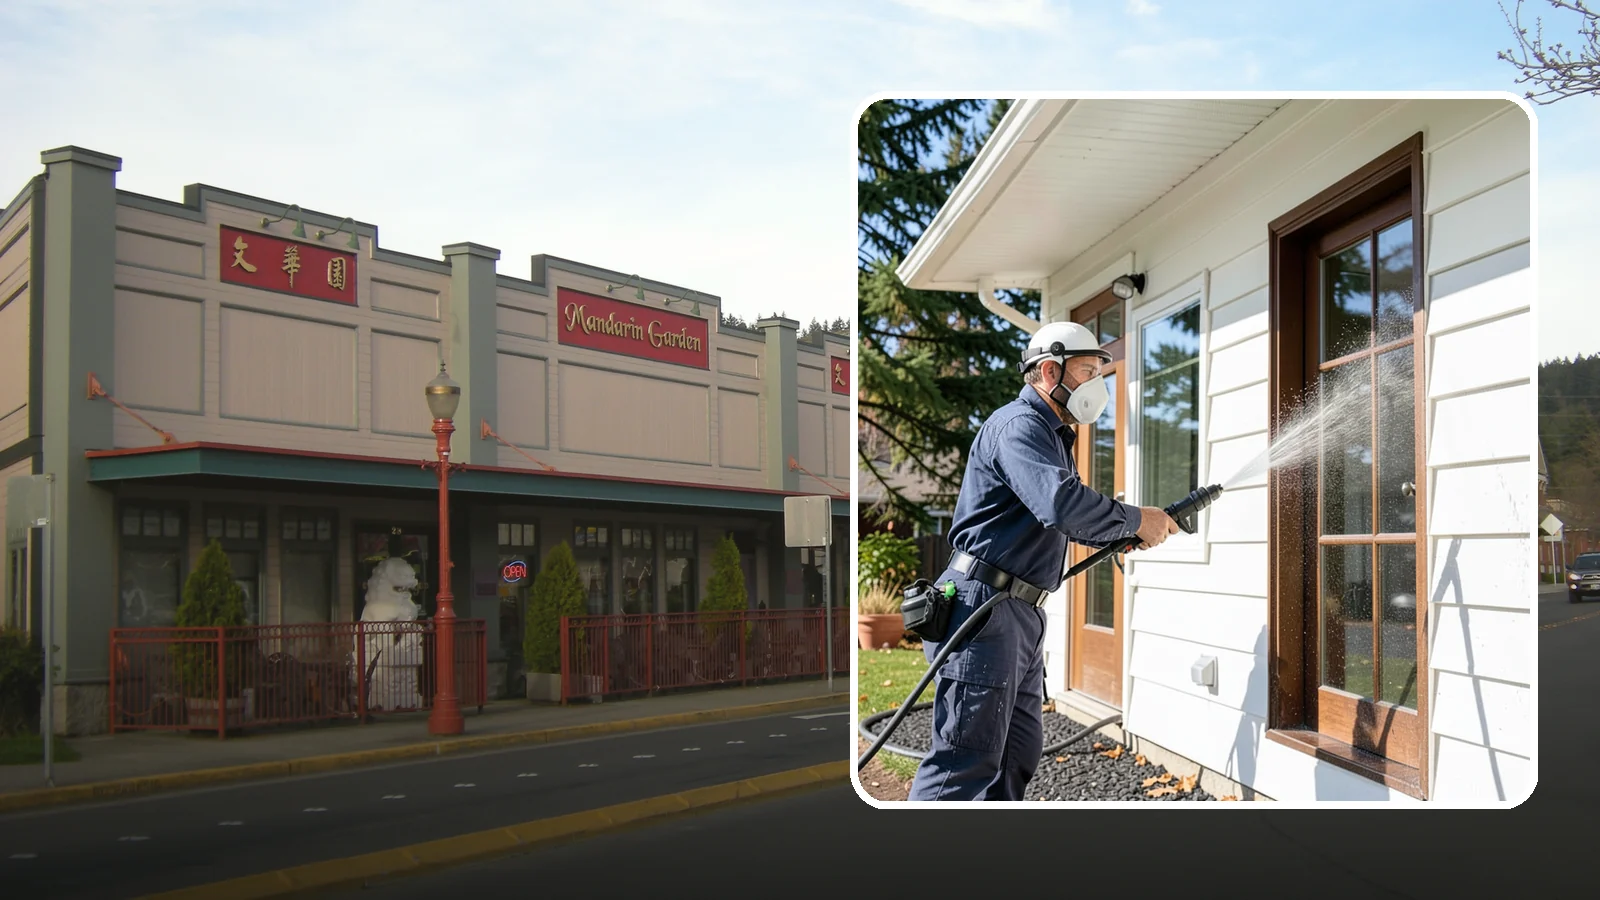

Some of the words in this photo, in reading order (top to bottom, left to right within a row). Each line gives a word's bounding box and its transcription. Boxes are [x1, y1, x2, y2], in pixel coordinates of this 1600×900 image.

[231, 236, 346, 290] 文華園
[564, 302, 644, 341] Mandarin
[648, 320, 701, 352] Garden
[503, 565, 527, 579] OPEN
